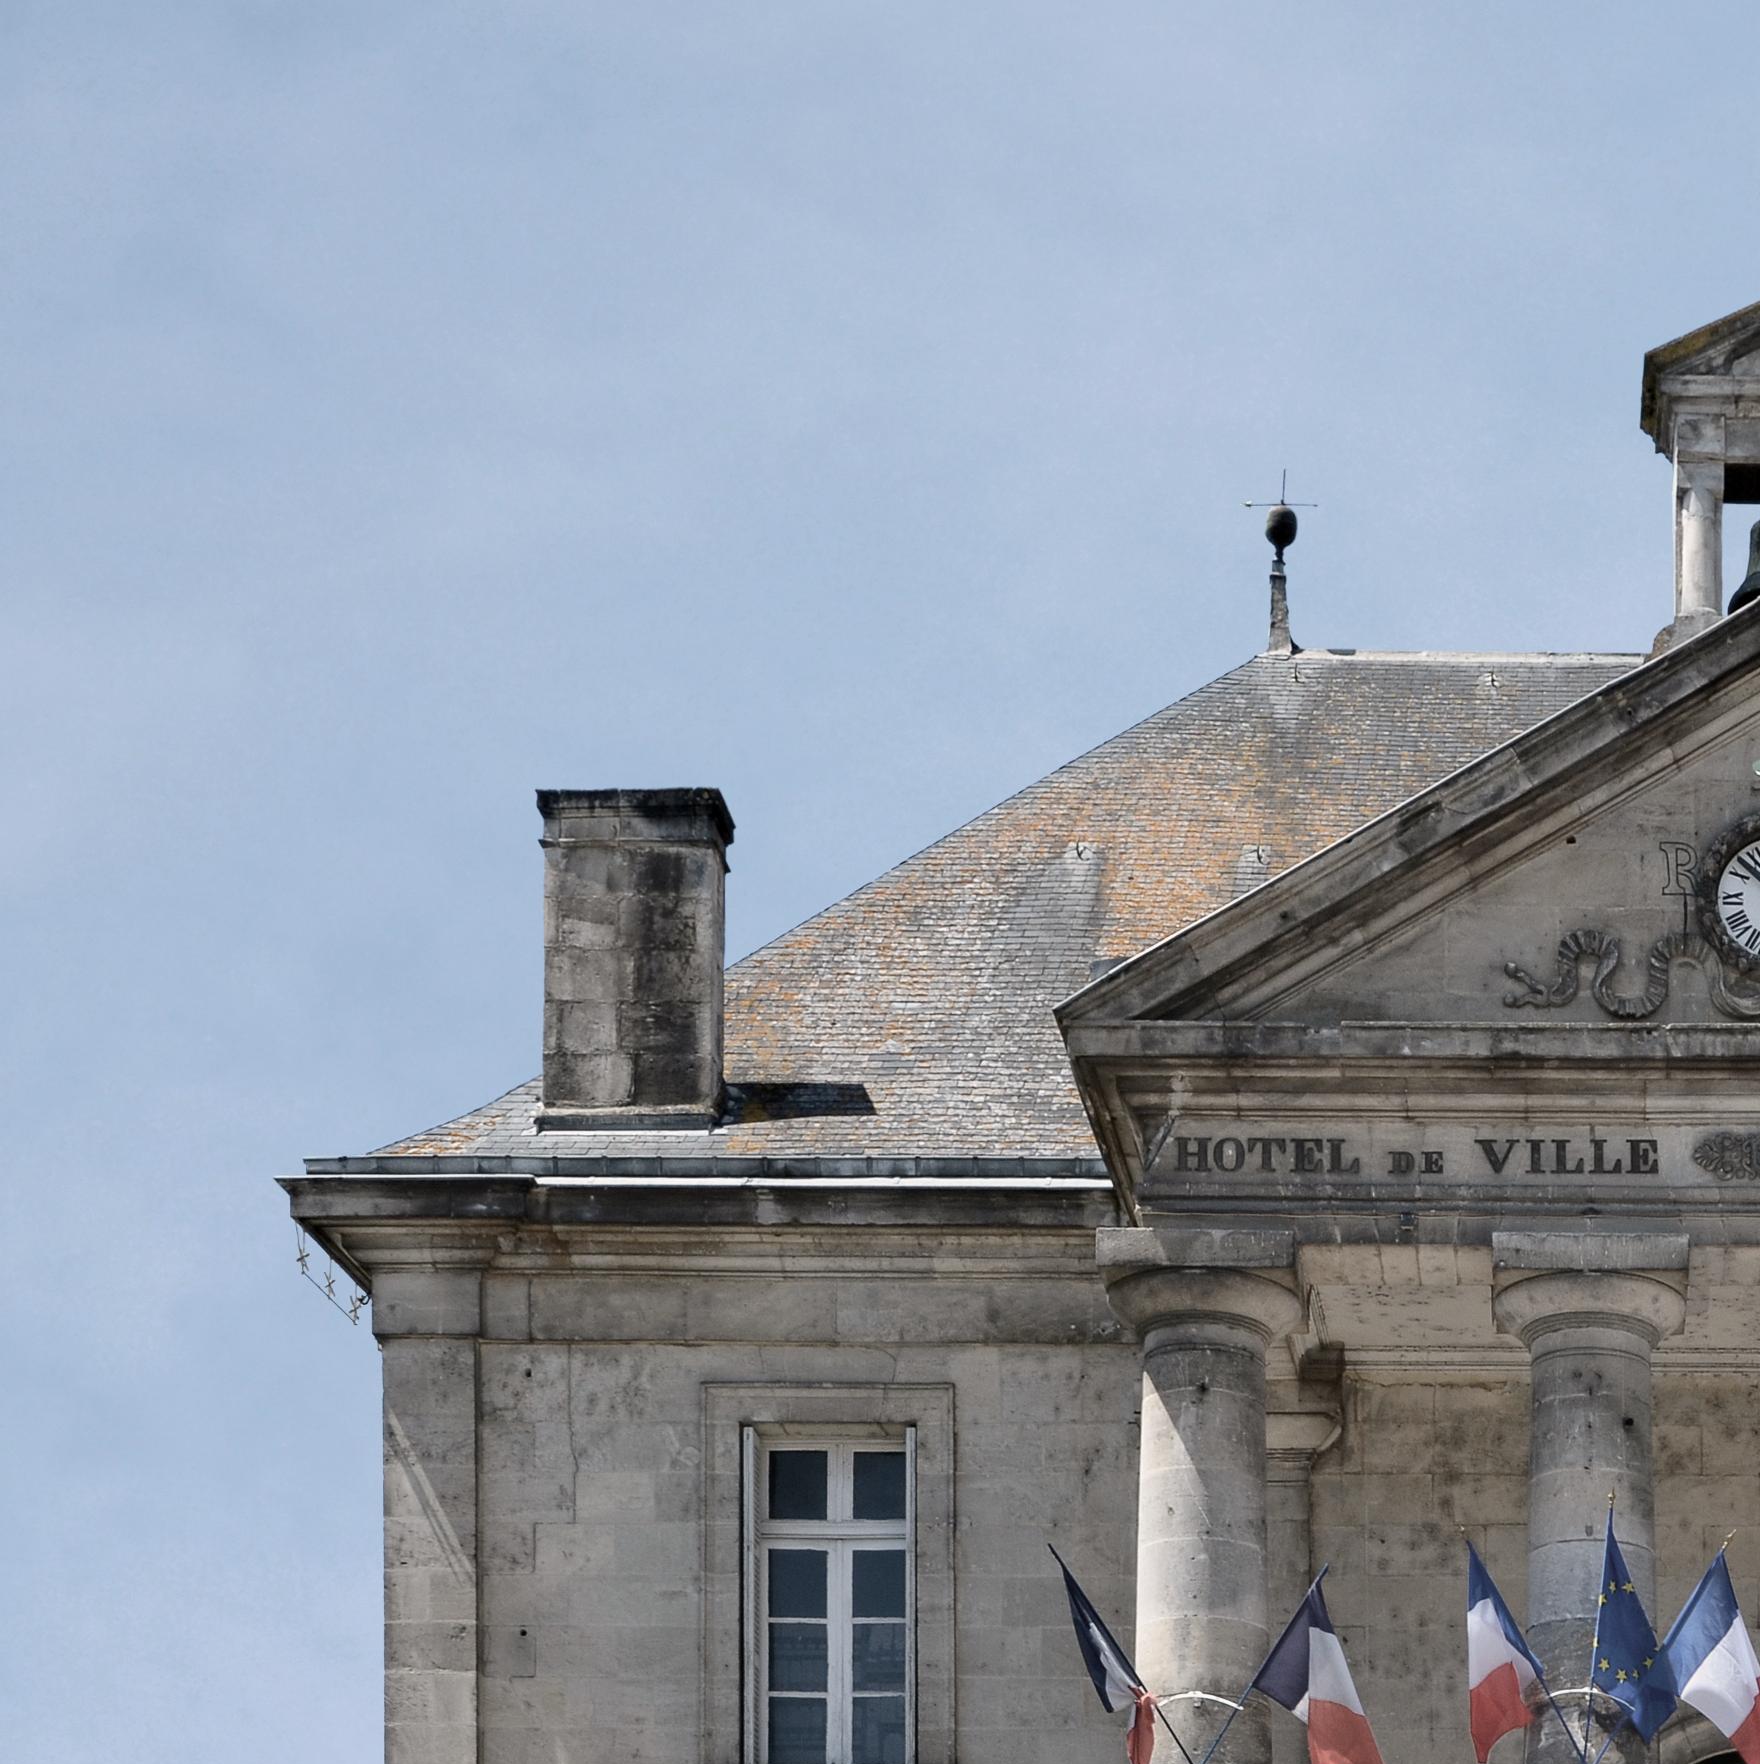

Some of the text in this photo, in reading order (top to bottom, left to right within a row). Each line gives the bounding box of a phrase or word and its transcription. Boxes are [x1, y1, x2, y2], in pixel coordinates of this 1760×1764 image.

[1659, 841, 1699, 897] R
[1722, 891, 1744, 905] IX
[1725, 909, 1752, 939] VIII
[1174, 1136, 1659, 1175] HOTEL DE VILLE
